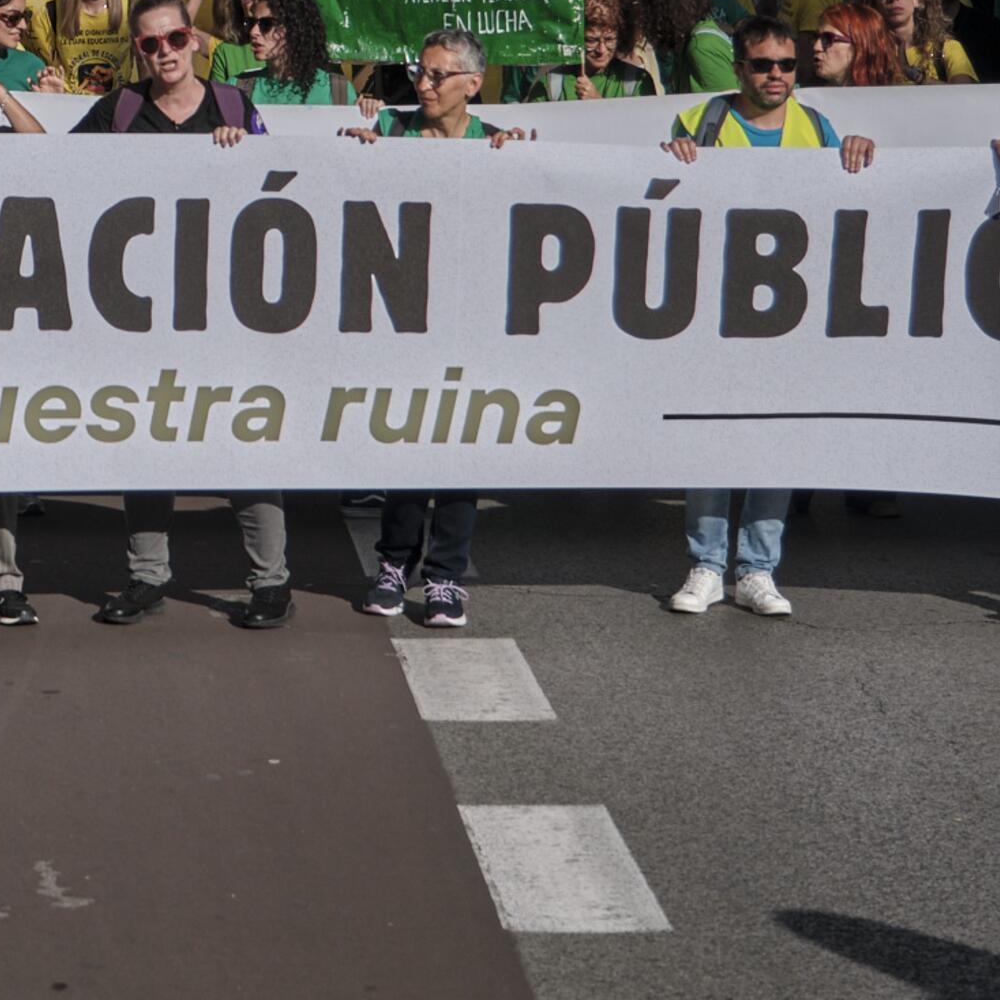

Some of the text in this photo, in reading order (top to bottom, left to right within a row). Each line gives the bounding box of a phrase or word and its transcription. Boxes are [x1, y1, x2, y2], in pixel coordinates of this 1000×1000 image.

[443, 9, 534, 35] EN LUCHA
[320, 366, 582, 446] ruina
